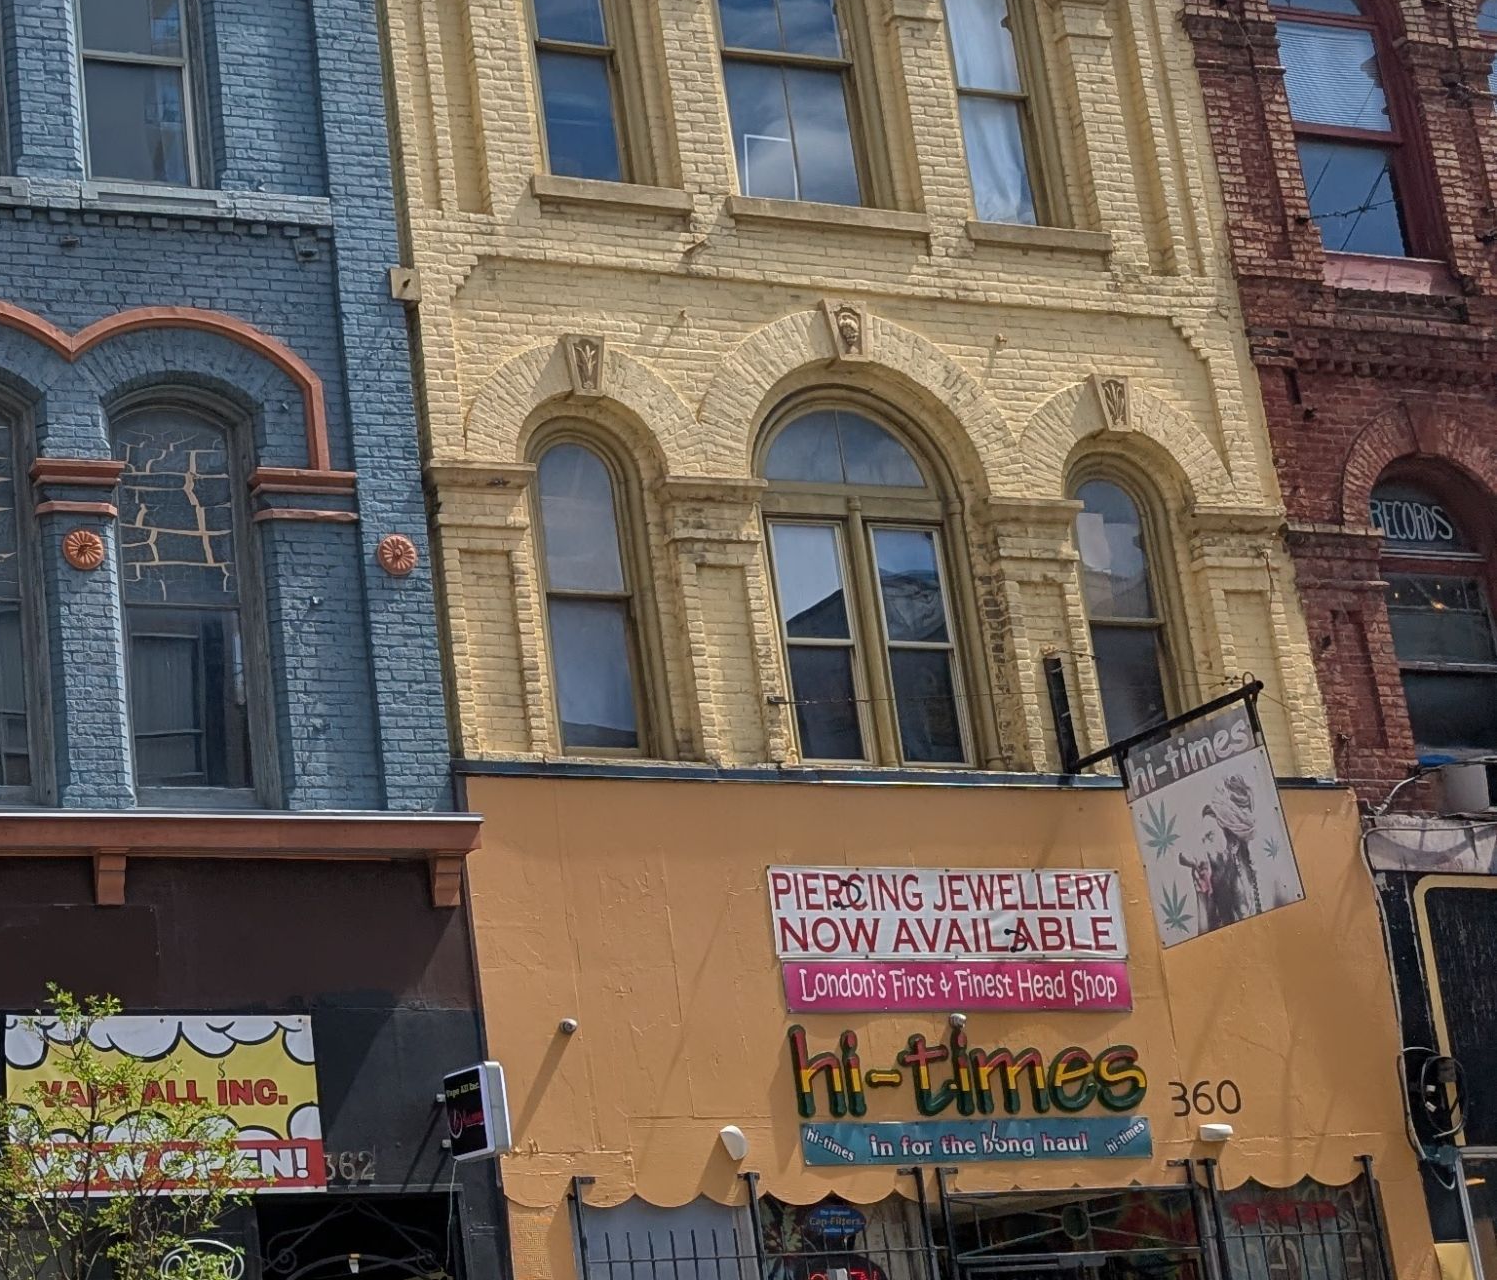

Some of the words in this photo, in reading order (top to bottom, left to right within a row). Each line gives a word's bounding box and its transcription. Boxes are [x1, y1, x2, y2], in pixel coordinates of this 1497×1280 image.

[1368, 500, 1453, 541] RECORDS
[1125, 719, 1251, 798] hi-times
[772, 873, 924, 912] PIERCING
[933, 873, 1113, 912] JEWELLERY
[780, 916, 882, 953] NOW
[893, 915, 1118, 953] AVAILABLE
[799, 968, 886, 1002] London's
[889, 968, 935, 1001] First
[939, 972, 952, 999] &
[954, 968, 1012, 1001] Finest
[1017, 970, 1067, 1002] Head
[1071, 970, 1118, 1006] Shop
[788, 1023, 1148, 1118] hi-times
[142, 1079, 208, 1106] ALL
[216, 1077, 289, 1106] INC.
[1167, 1078, 1243, 1117] 360
[806, 1127, 855, 1162] hi-times
[869, 1134, 894, 1158] in
[902, 1133, 933, 1156] for
[940, 1133, 976, 1156] the
[1042, 1131, 1089, 1152] haul
[1106, 1120, 1146, 1155] hi-times
[157, 1147, 311, 1181] OPEN!
[325, 1149, 376, 1182] 362
